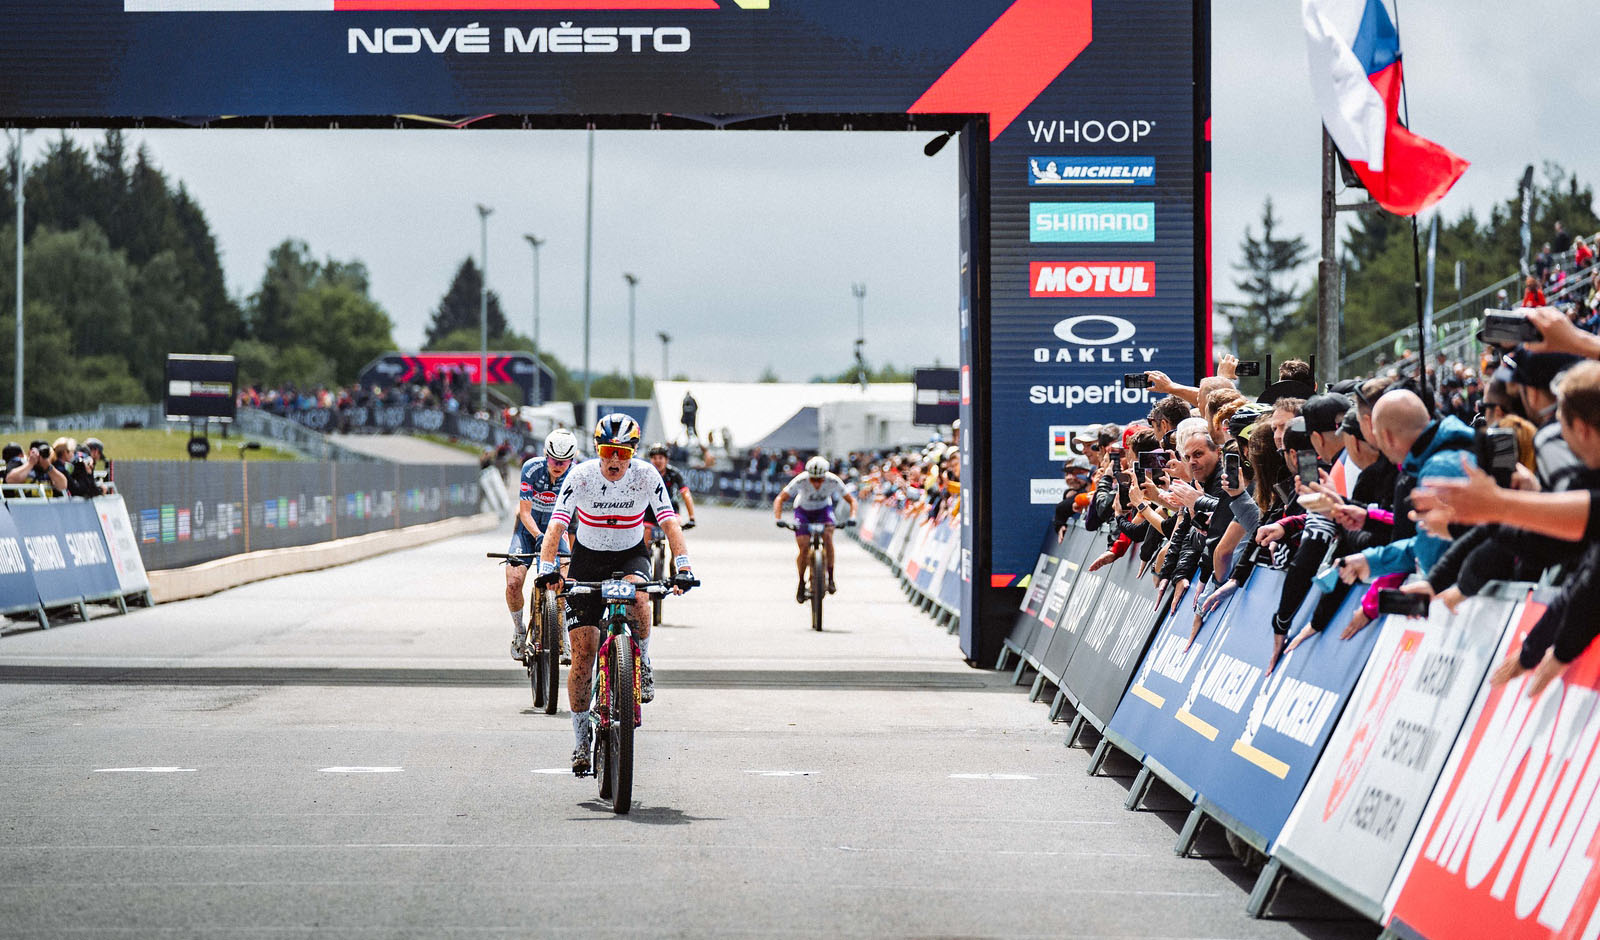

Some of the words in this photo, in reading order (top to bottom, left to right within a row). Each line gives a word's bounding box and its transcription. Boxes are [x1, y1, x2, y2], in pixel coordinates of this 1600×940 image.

[348, 22, 490, 54] NOVÉ
[504, 21, 691, 53] MĚSTO
[1027, 120, 1151, 143] WHOOP
[1062, 165, 1154, 178] MICHELIN
[1036, 213, 1149, 232] SHIMANO
[1034, 266, 1150, 293] MOTUL
[1033, 347, 1155, 363] OAKLEY
[1034, 487, 1065, 496] WHOO
[592, 500, 635, 509] SPECIALIZED
[607, 584, 631, 596] 20
[1200, 652, 1263, 714] MICHELIN
[1262, 676, 1340, 747] MICHELIN
